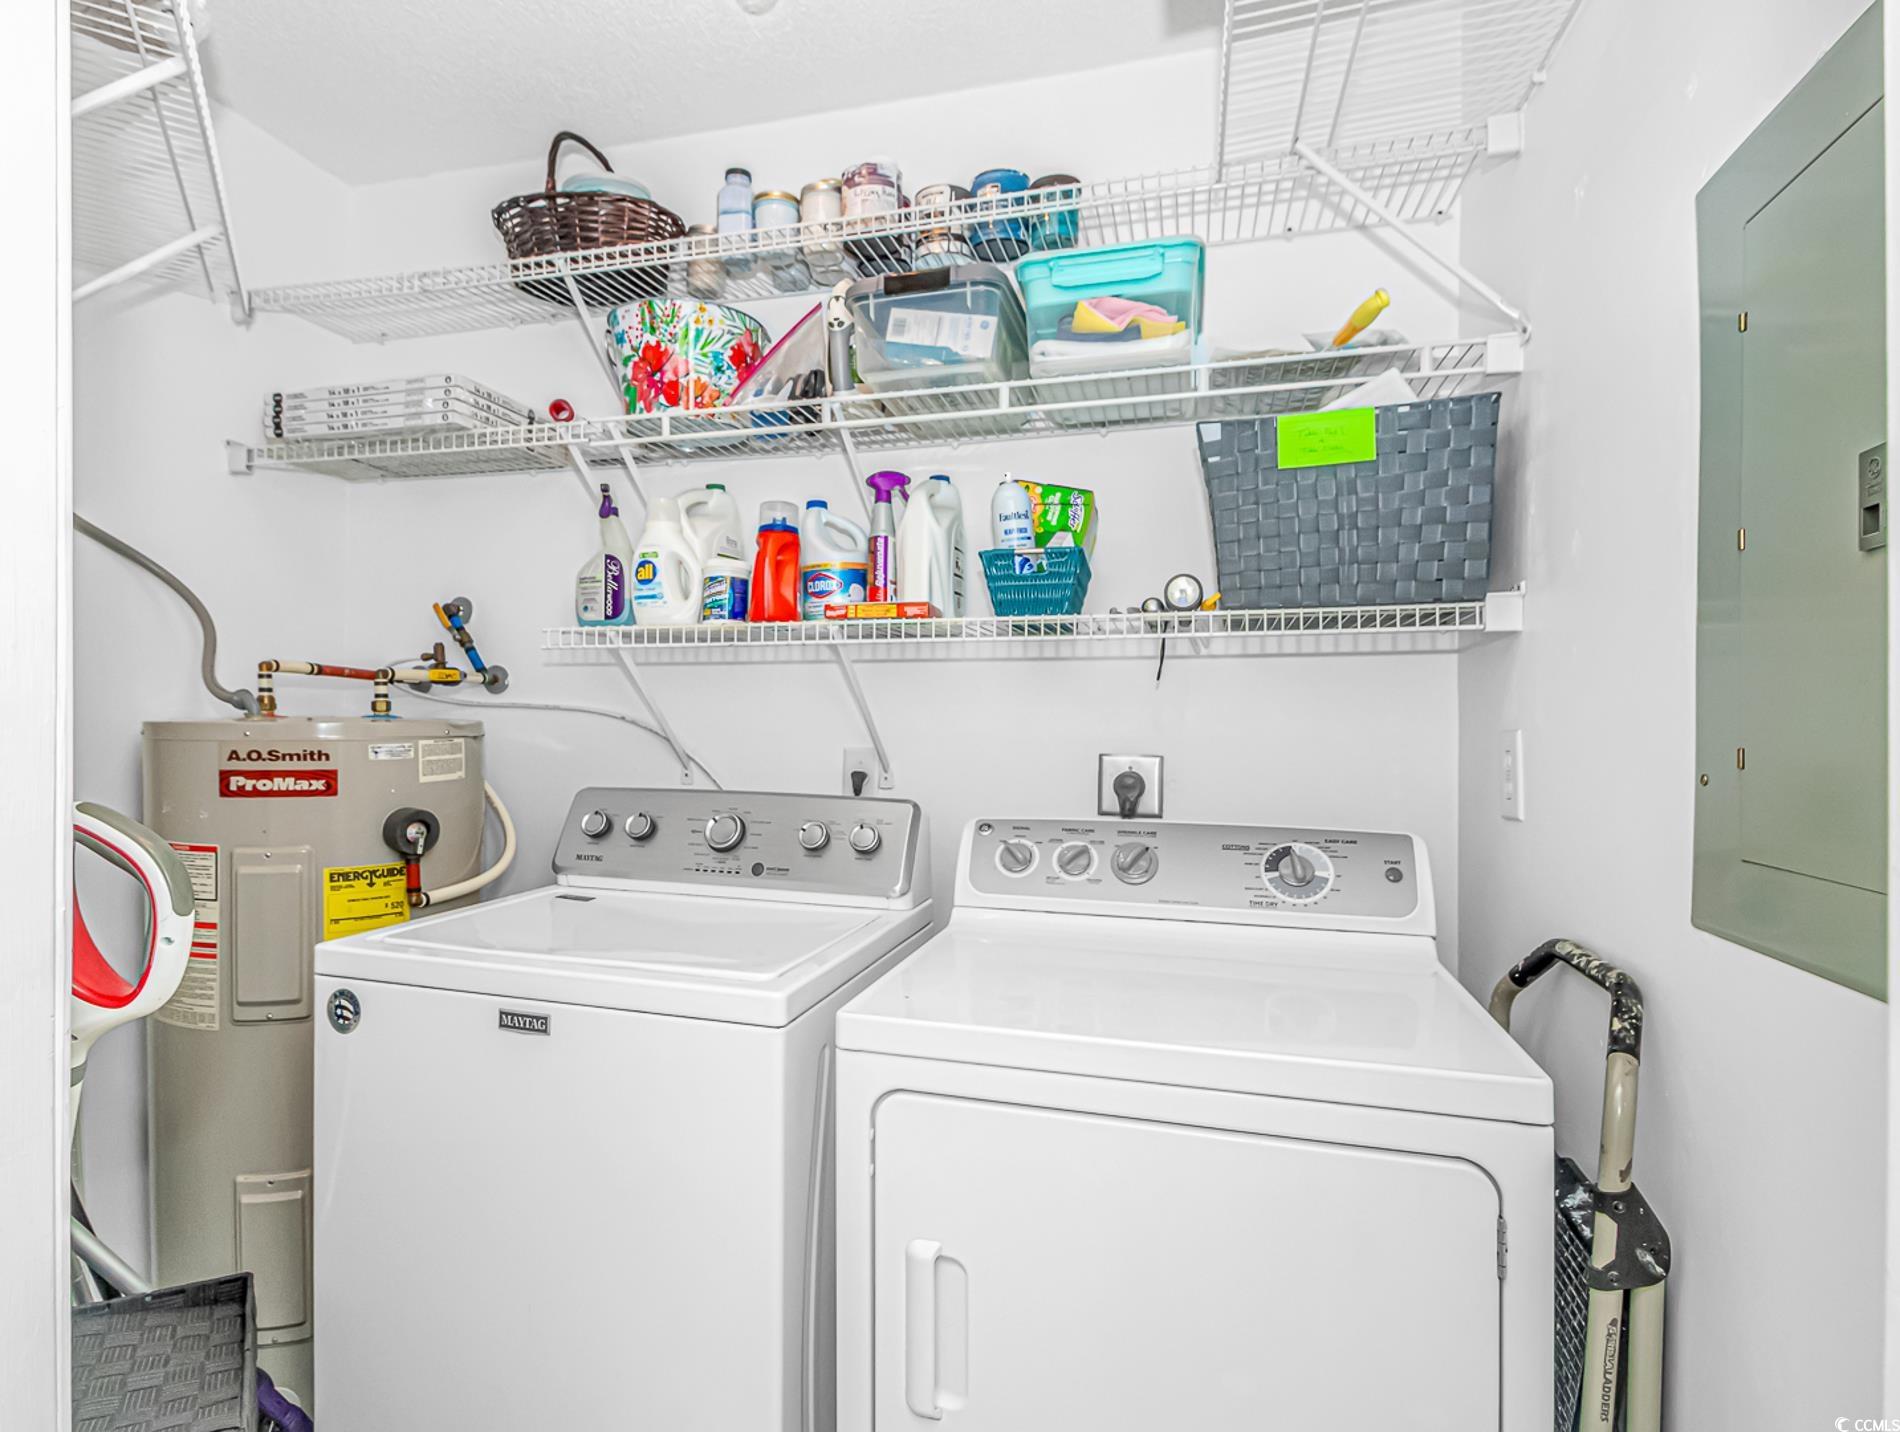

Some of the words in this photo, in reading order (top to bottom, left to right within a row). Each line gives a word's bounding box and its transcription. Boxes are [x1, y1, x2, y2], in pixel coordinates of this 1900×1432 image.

[637, 567, 653, 580] all
[226, 749, 331, 762] A.O.Smith
[228, 776, 328, 791] ProMax
[501, 1013, 546, 1030] MAYTAG
